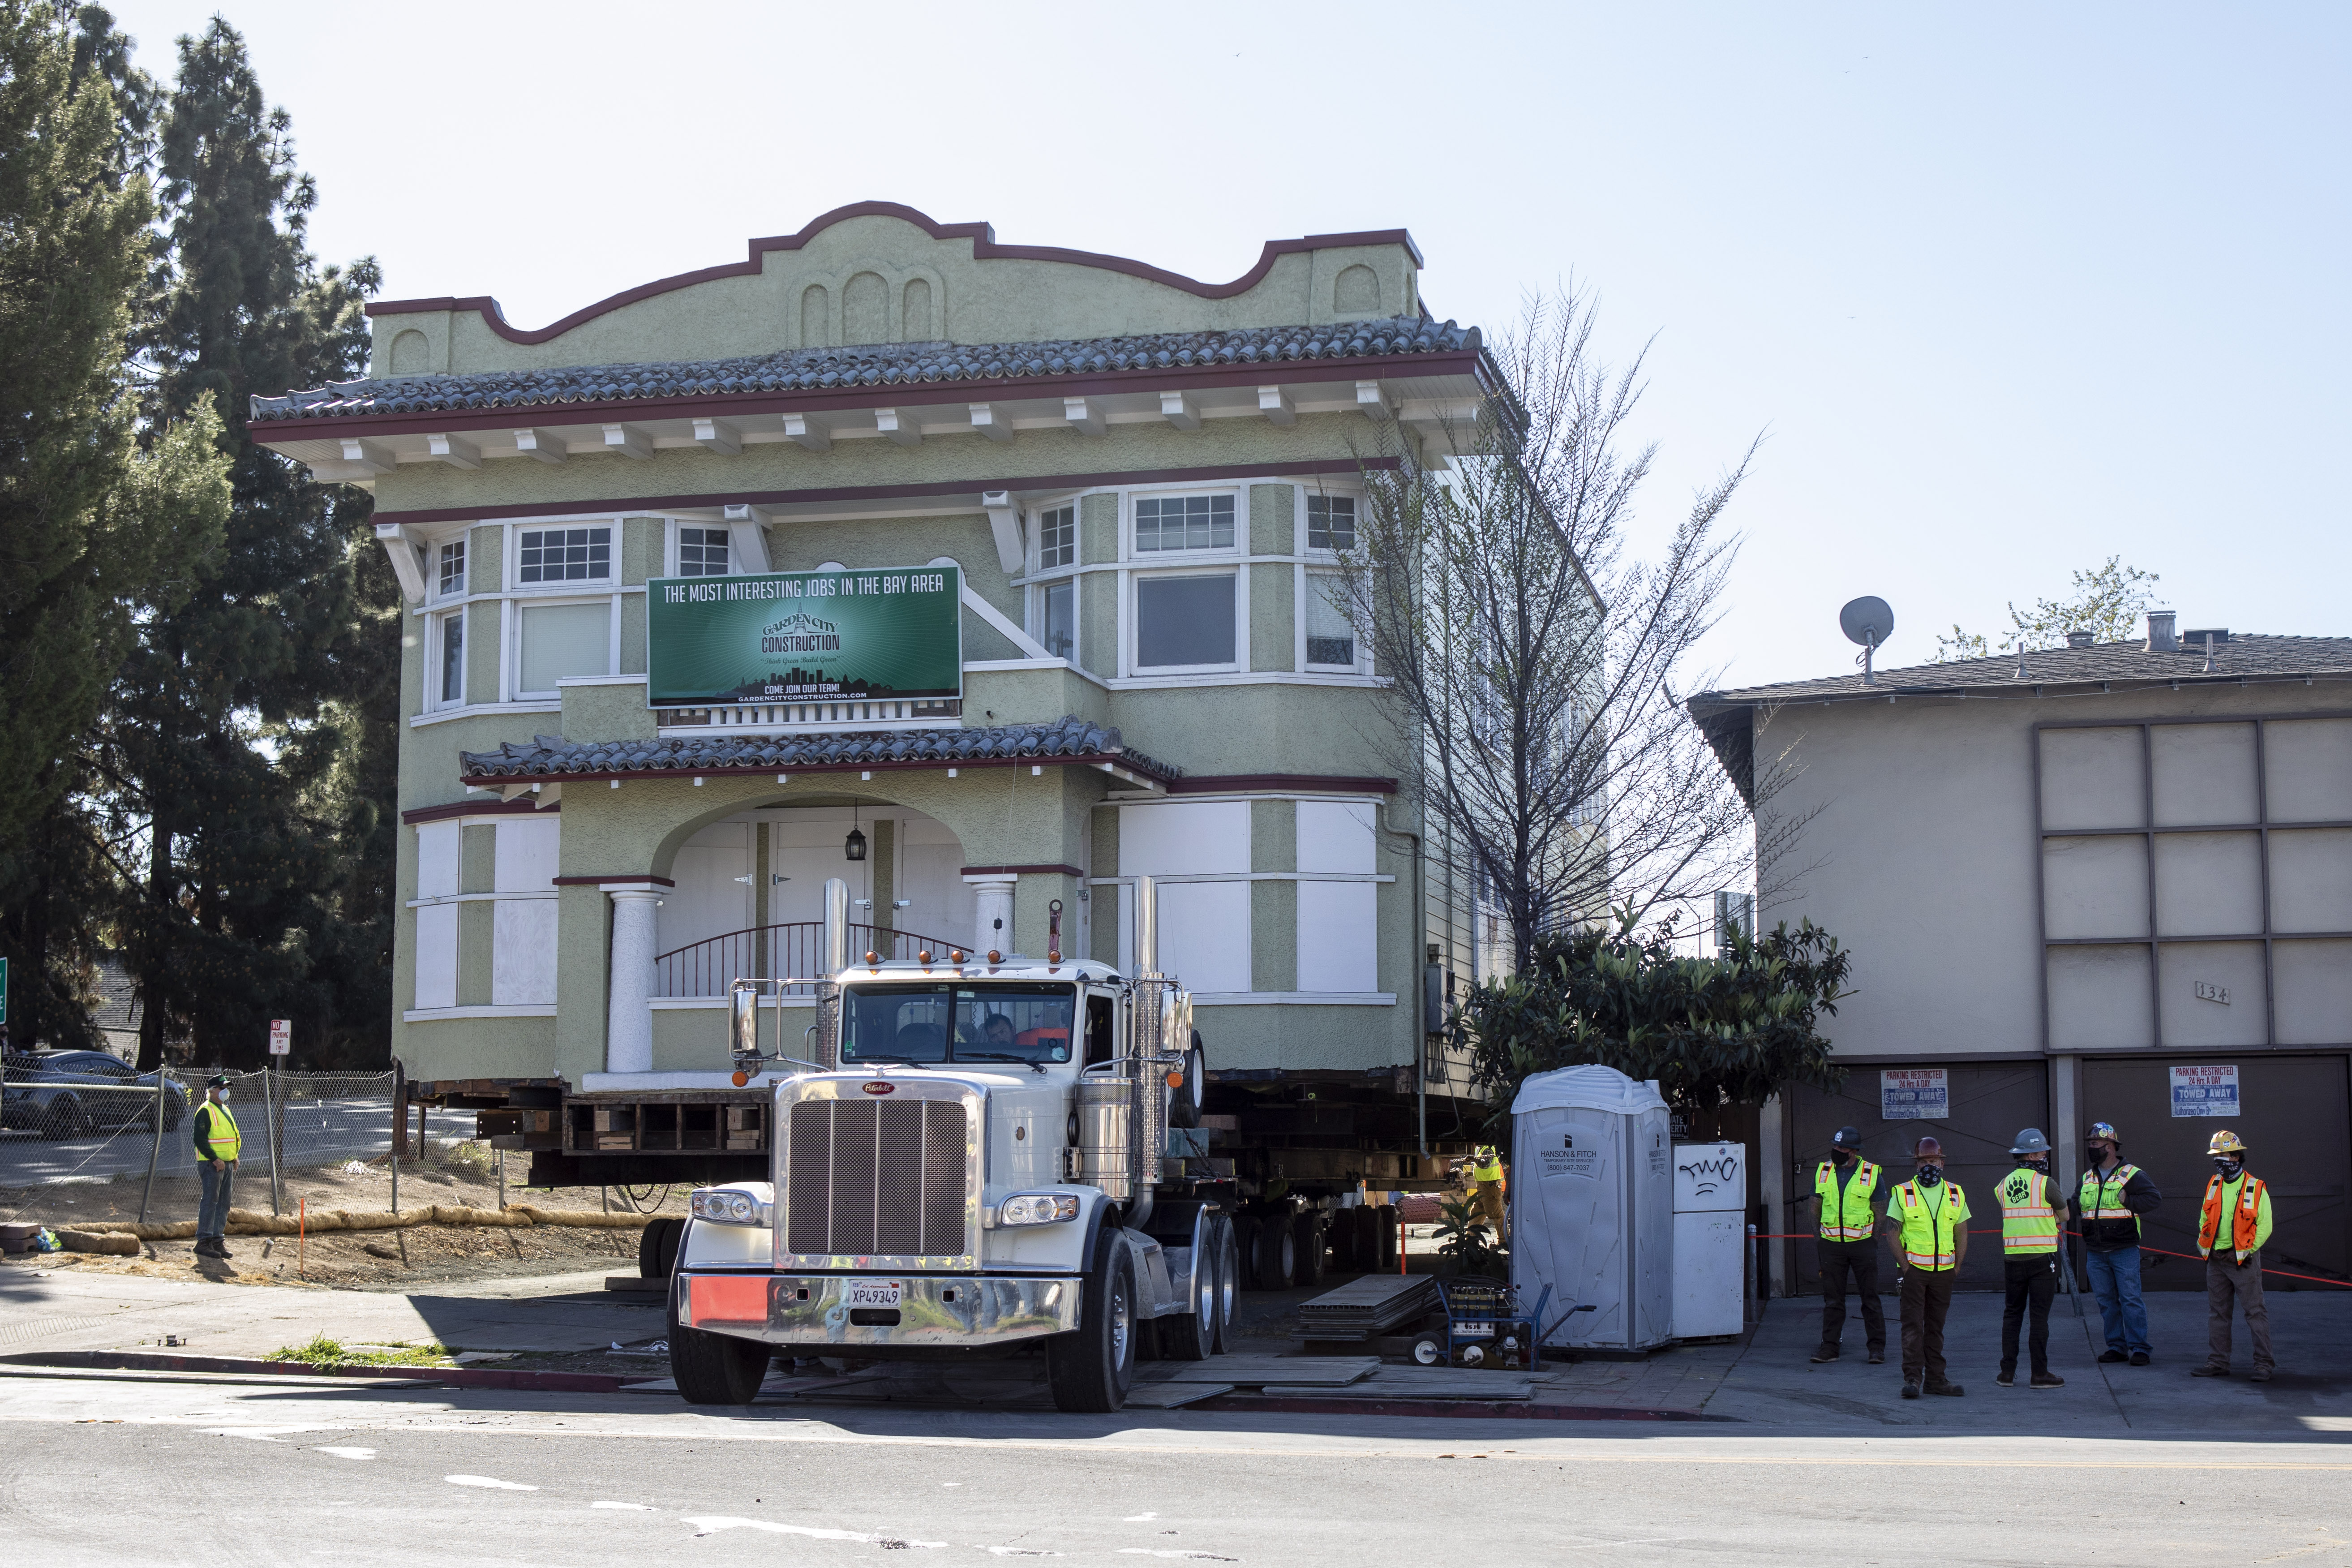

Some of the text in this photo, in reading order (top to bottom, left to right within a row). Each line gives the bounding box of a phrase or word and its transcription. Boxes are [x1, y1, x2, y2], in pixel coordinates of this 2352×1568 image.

[664, 574, 944, 603] THE MOST INTERESTING JOBS IN THE BAY AREA
[763, 613, 839, 636] GARDEN CITY
[762, 634, 840, 653] CONSTRUCTION
[783, 657, 799, 665] Green
[765, 683, 840, 694] COME JOIN OUR TEAM!
[738, 693, 867, 702] GARDENCITYCONSTRUCTION.COM
[2201, 984, 2226, 1003] 134
[1886, 1070, 1943, 1080] PARKING RESTRICTED
[2176, 1066, 2234, 1076] PARKING RESTRICTED
[2189, 1076, 2221, 1085] 24 Hrs. A DAY
[865, 1083, 893, 1092] Peterbilt
[1889, 1092, 1915, 1101] TOWED
[2179, 1088, 2231, 1098] TOWED AWAY
[2175, 1107, 2196, 1116] Authorized
[2012, 1191, 2026, 1203] BEAR
[853, 1290, 898, 1303] XP49349
